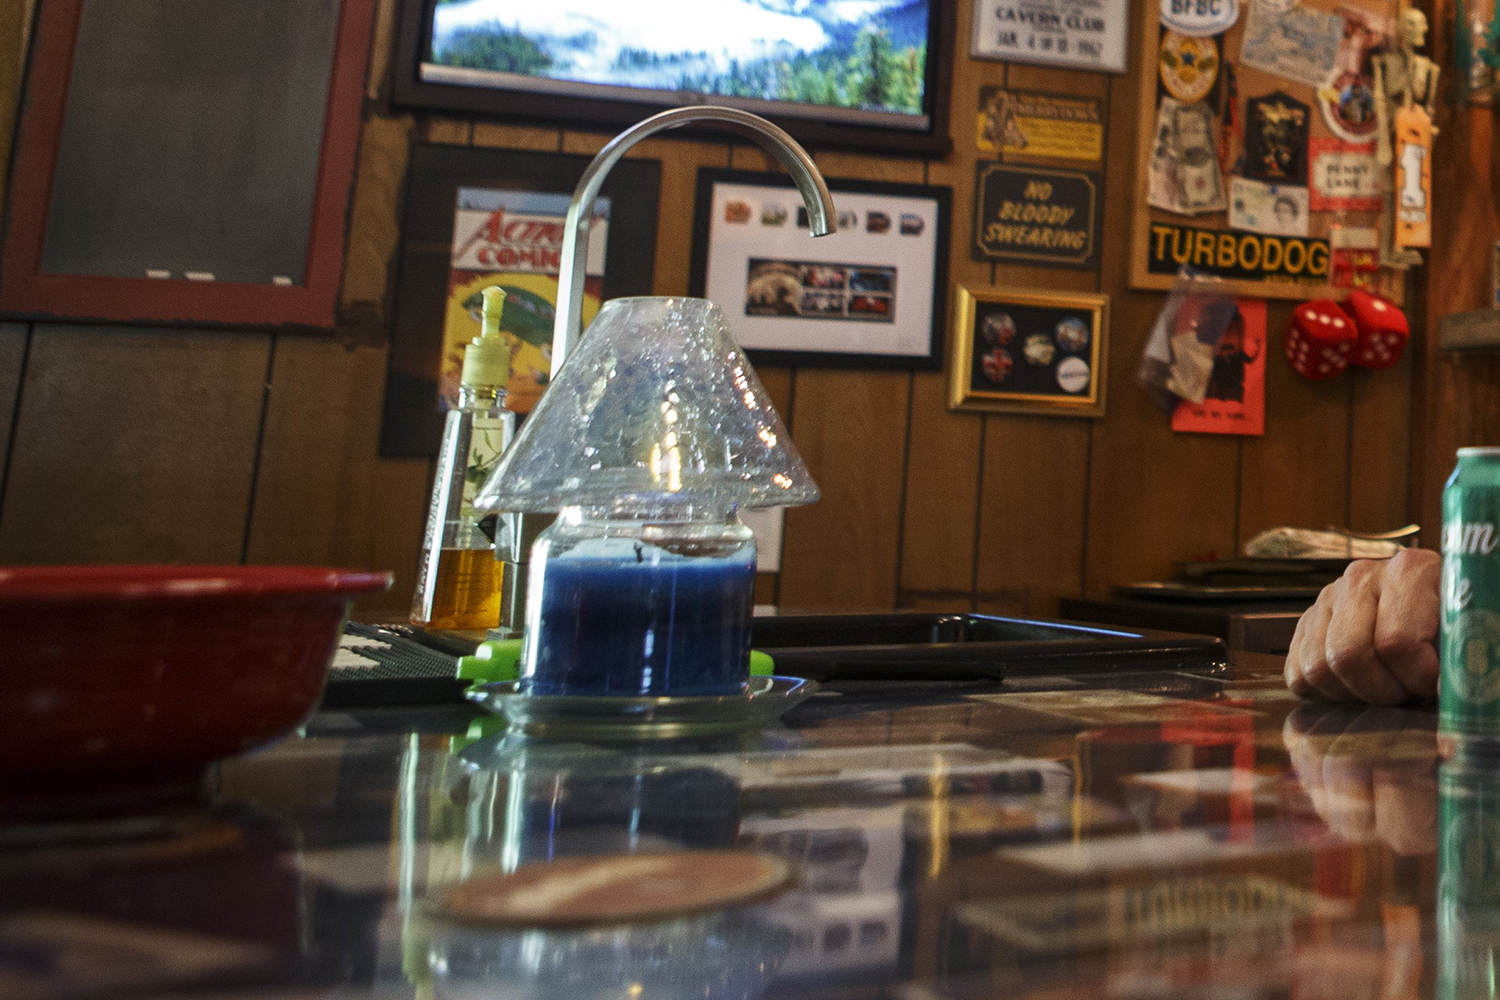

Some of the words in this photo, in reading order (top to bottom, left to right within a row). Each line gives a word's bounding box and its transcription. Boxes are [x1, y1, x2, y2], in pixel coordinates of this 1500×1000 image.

[995, 5, 1061, 25] CAVERN
[1023, 181, 1053, 201] NO
[998, 201, 1076, 226] BLOODY
[983, 222, 1088, 250] SWEARING
[1152, 225, 1330, 276] TURBODOG
